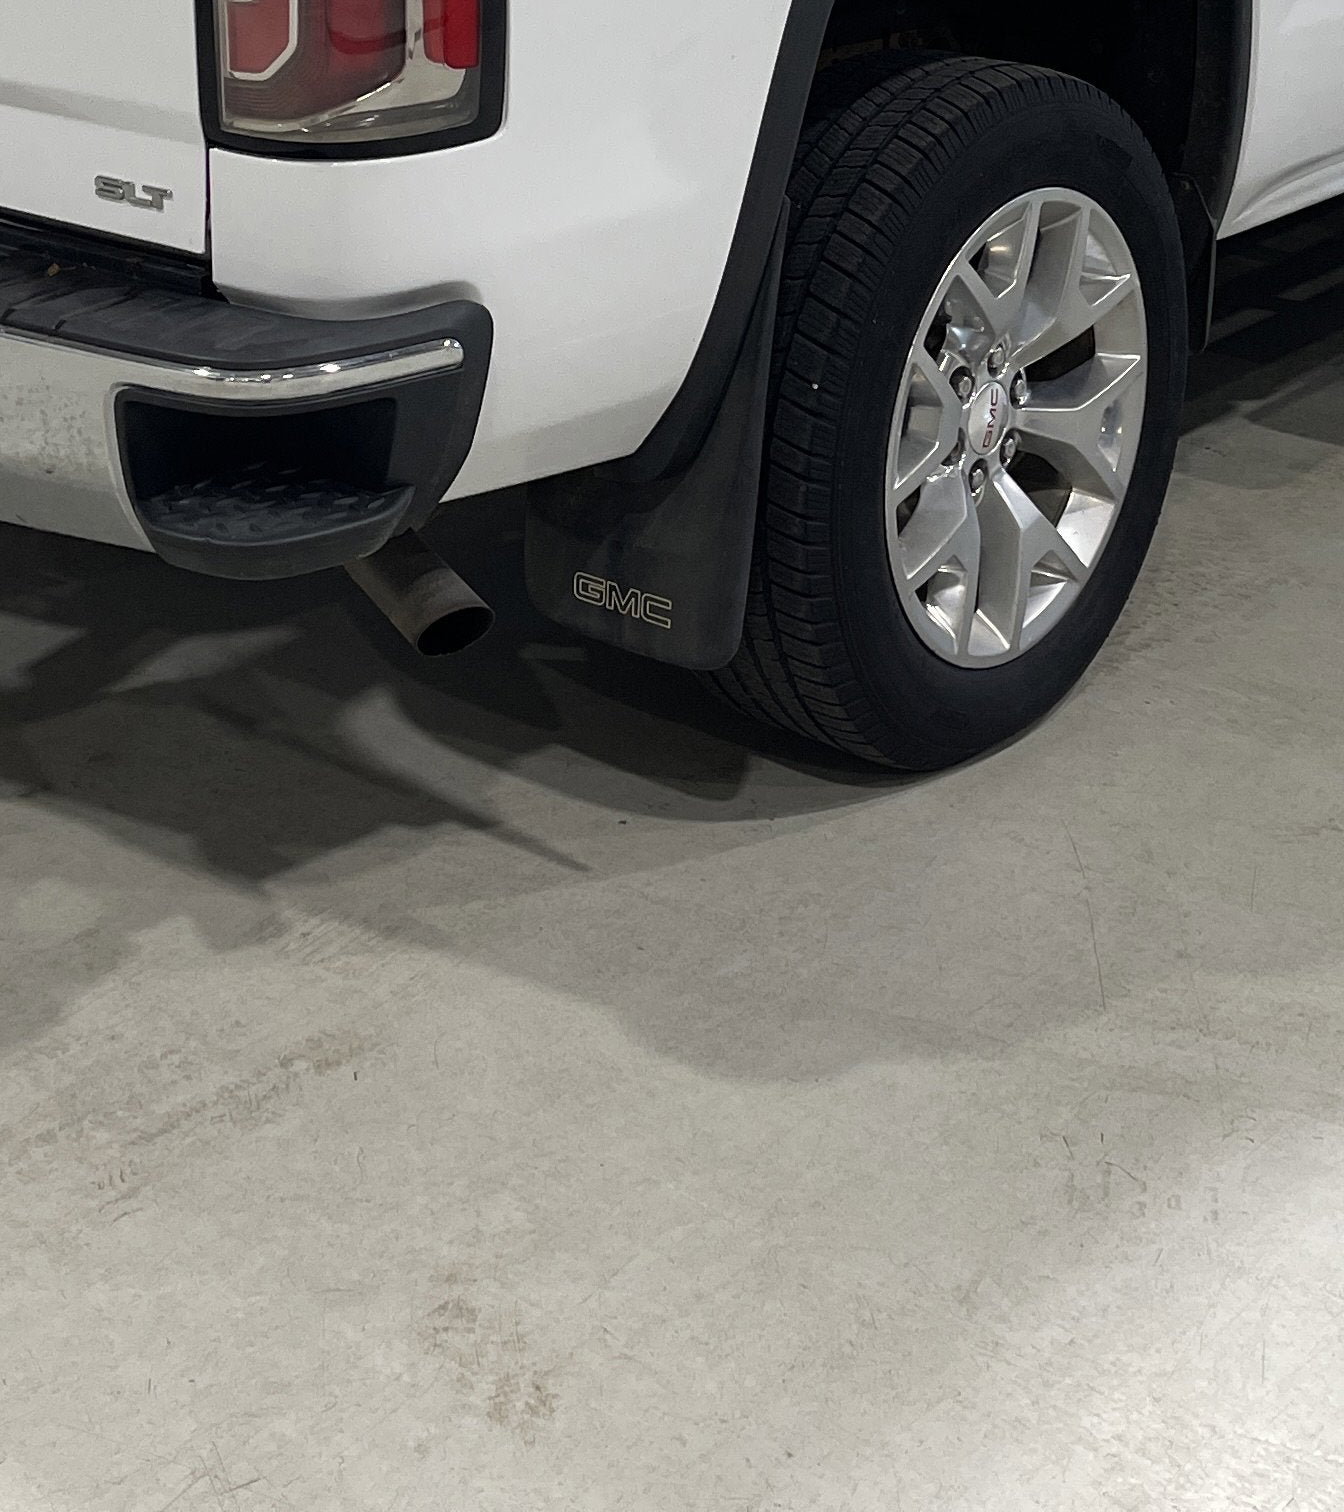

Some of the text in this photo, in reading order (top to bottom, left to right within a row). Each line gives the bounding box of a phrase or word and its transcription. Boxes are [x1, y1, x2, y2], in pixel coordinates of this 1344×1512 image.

[94, 175, 173, 210] SLT
[982, 388, 998, 448] GMC
[574, 571, 672, 629] GMC
